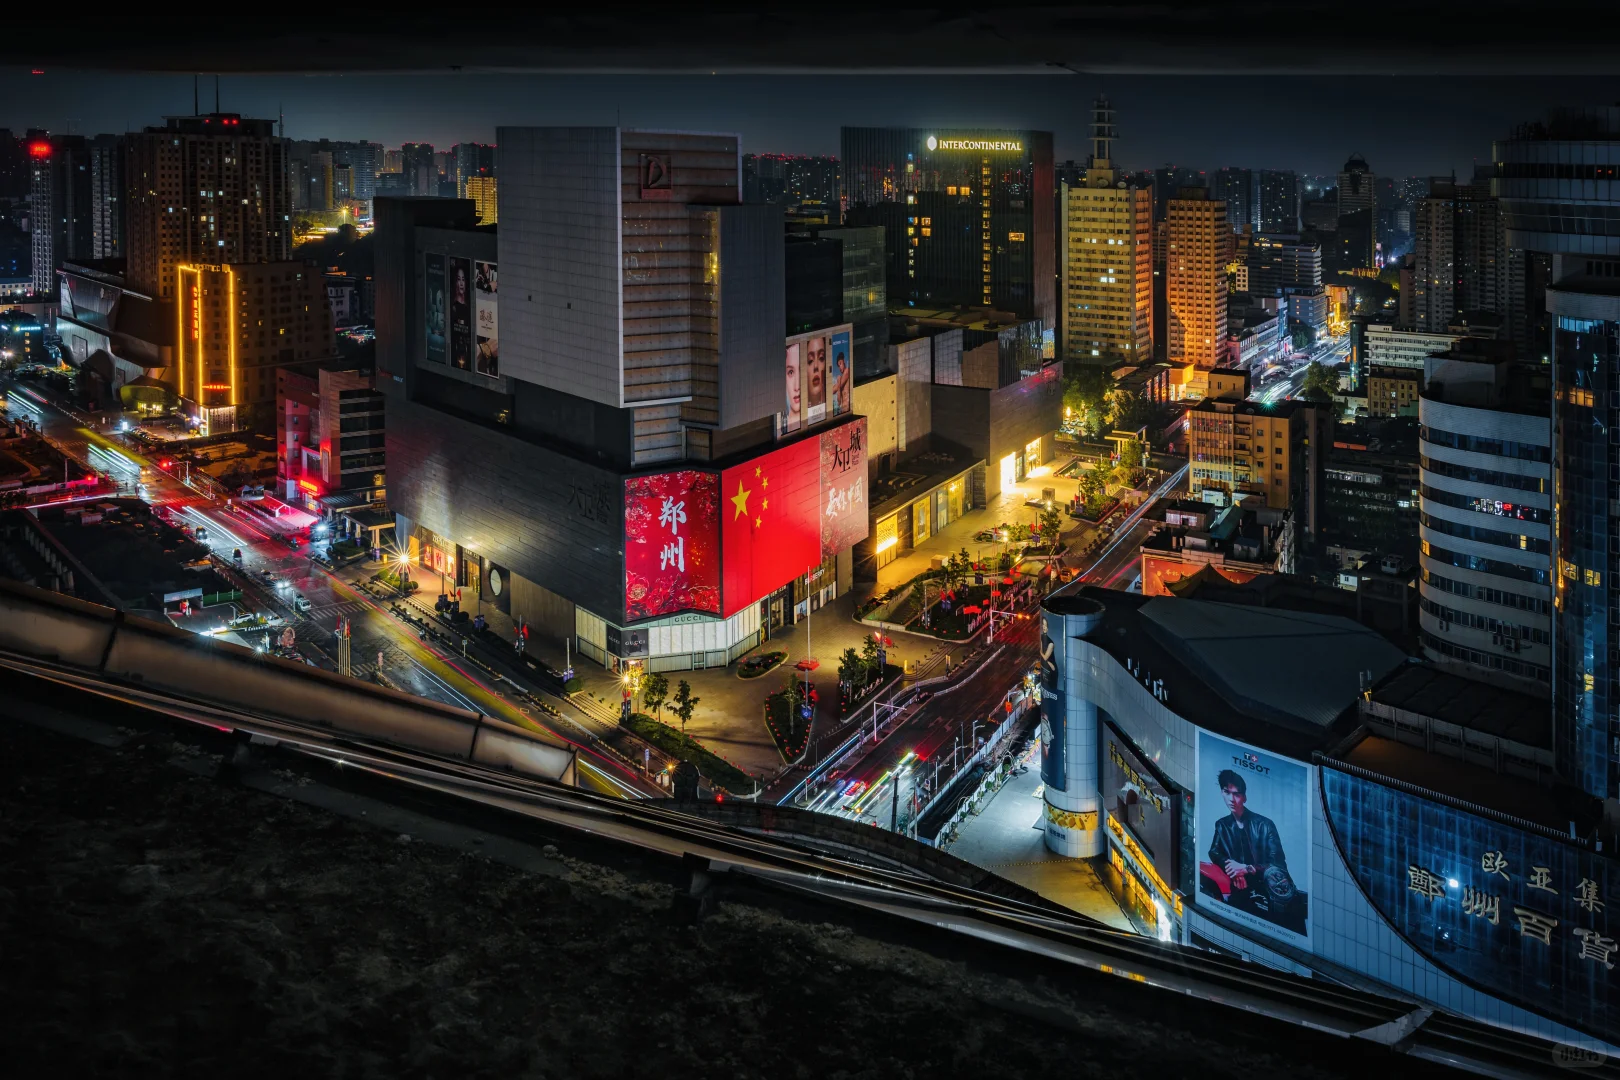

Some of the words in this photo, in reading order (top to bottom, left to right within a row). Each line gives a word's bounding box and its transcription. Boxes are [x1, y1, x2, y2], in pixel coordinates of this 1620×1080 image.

[939, 139, 1021, 151] INTERCONTINENTAL
[830, 427, 861, 473] 大卫城
[657, 495, 687, 573] 郑州
[674, 615, 702, 623] GUCCI
[1232, 756, 1270, 775] TISSOT
[1481, 850, 1605, 913] 欧亚集
